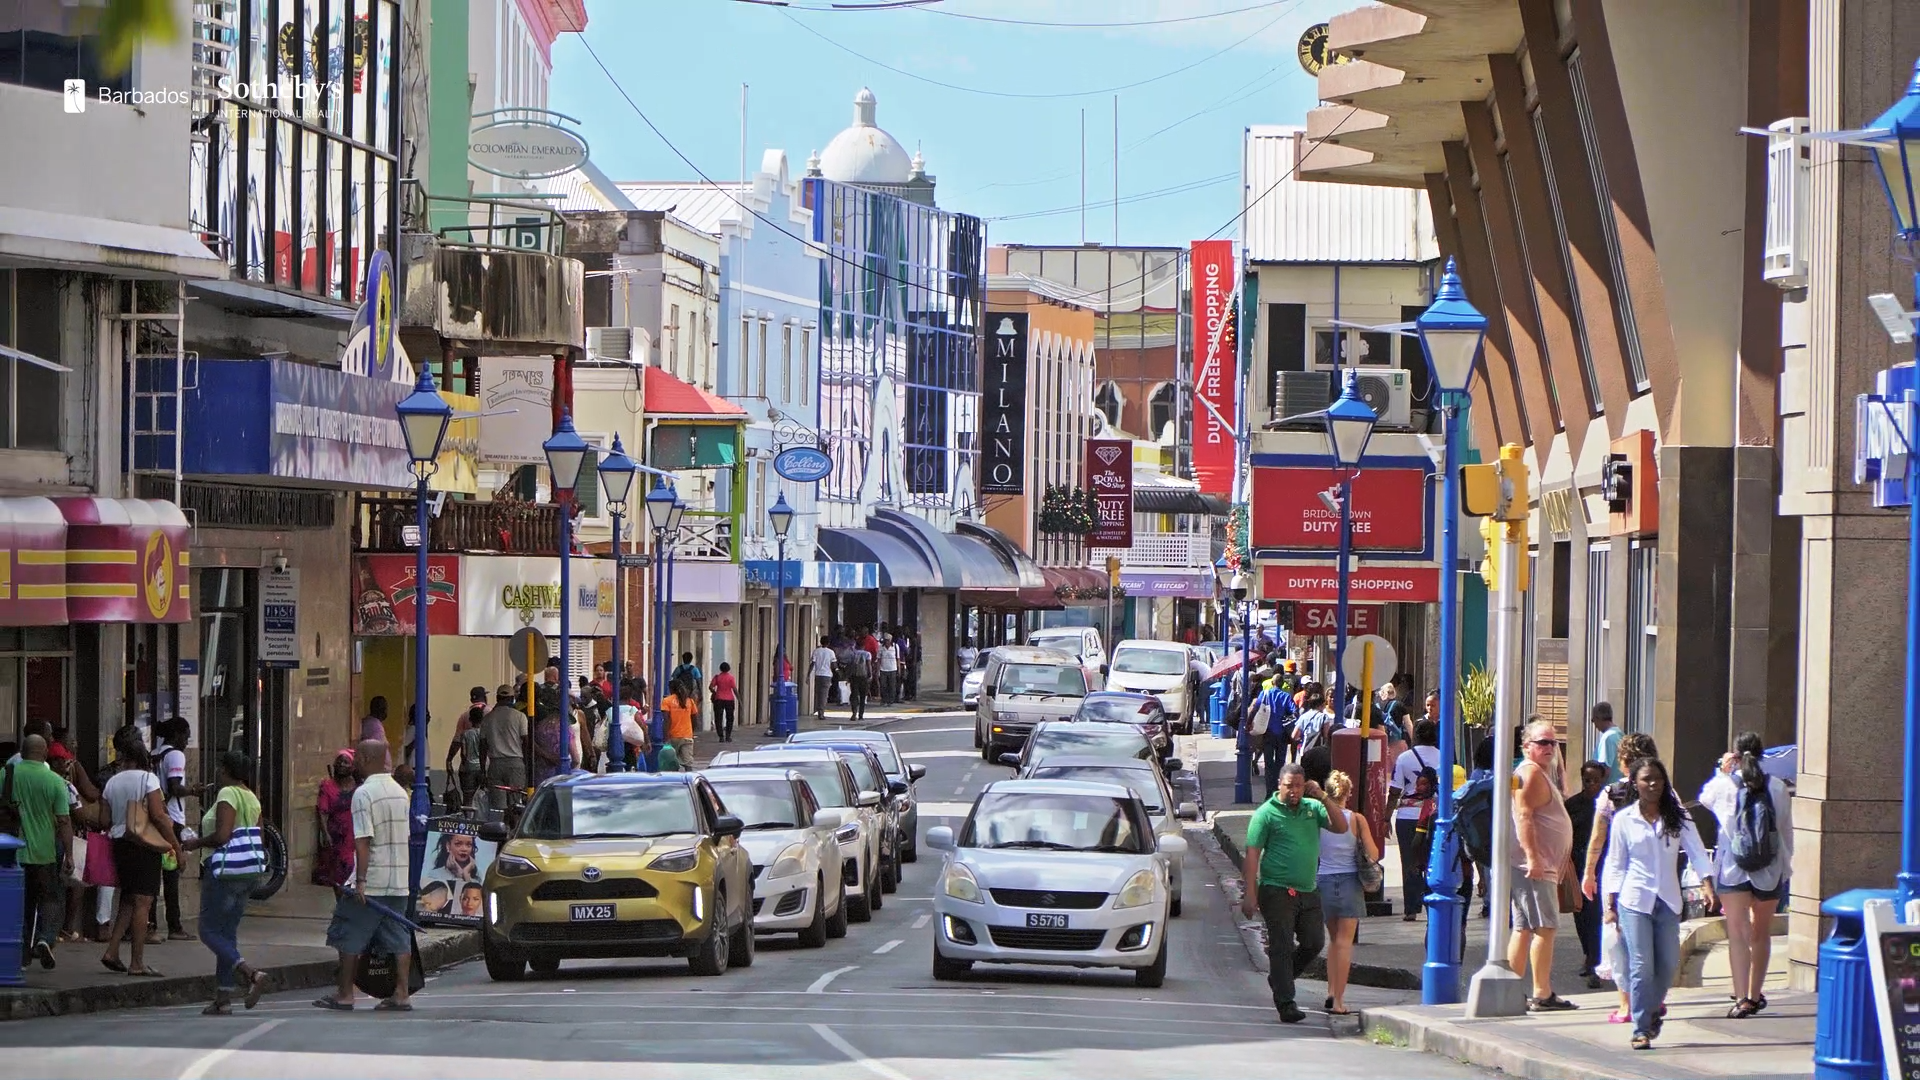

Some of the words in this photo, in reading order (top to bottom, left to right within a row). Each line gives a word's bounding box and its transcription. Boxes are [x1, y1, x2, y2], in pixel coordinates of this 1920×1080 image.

[473, 143, 529, 154] COLOMBIAN
[531, 145, 578, 156] EMERALDS
[1205, 263, 1221, 353] SHOPPING
[1208, 357, 1221, 397] FREE
[993, 338, 1015, 484] MILANO
[1208, 401, 1221, 444] DUTY
[783, 455, 826, 470] Collins
[1092, 474, 1125, 488] ROYAL
[1101, 510, 1125, 520] REE
[1303, 509, 1372, 519] BRIDGEOWN
[1303, 521, 1338, 532] DUTY
[1153, 582, 1186, 590] FASTCASH
[1288, 578, 1320, 588] DUTY
[1351, 579, 1414, 590] SHOPPING
[679, 610, 720, 619] ROMANA
[268, 642, 290, 650] Security
[437, 820, 459, 830] KING
[575, 906, 595, 919] MX
[596, 906, 611, 918] 25
[1030, 914, 1038, 926] S
[1039, 915, 1065, 927] 5716
